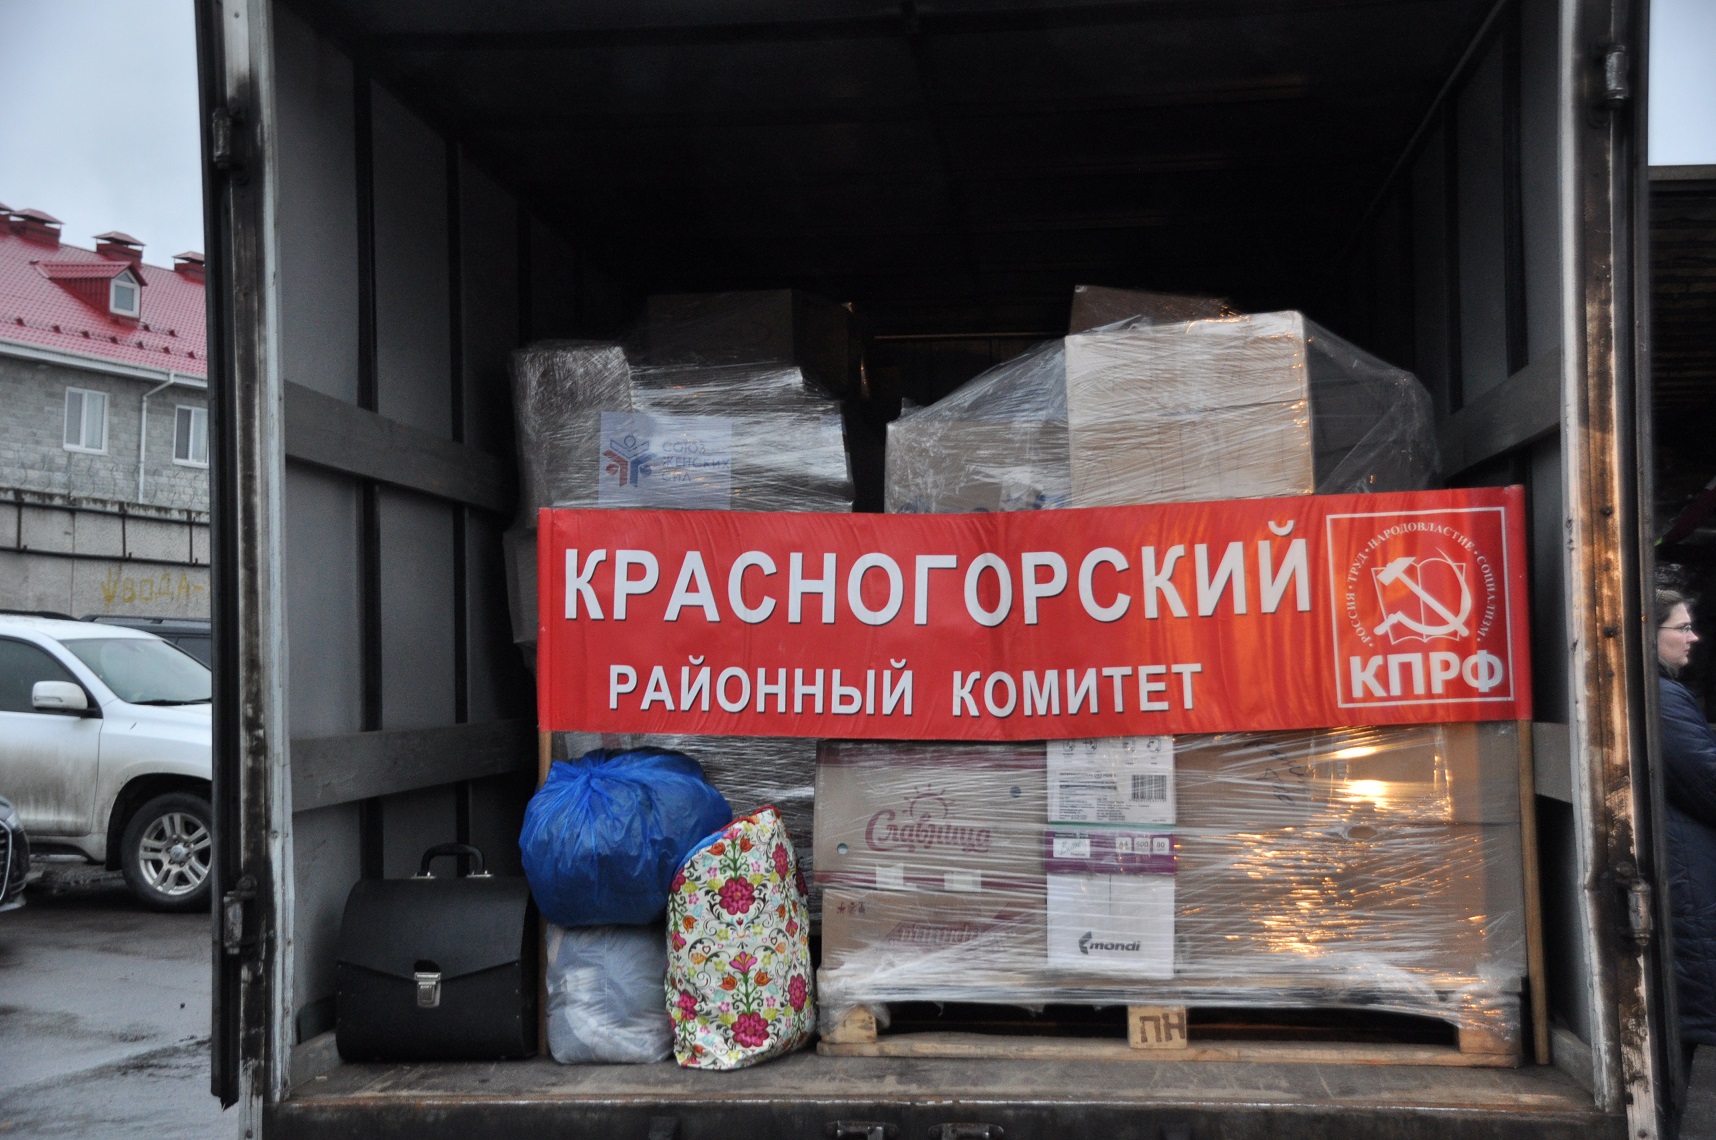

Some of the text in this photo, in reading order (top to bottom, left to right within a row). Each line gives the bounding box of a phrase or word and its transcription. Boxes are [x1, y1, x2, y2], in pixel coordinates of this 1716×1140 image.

[662, 440, 706, 454] СОЮЗ
[662, 456, 730, 469] ЖЕНСКИХ
[564, 519, 1312, 627] КРАСНОГОРСКИЙ
[1345, 521, 1496, 646] РОССИЯ ТРУД НАРОДОВЛАСТИЕ СОЦИАЛИЗМ
[609, 654, 1202, 719] РАЙОННЫЙ КОМИТЕТ
[1349, 649, 1503, 698] КПРФ
[1156, 841, 1165, 849] 80
[1089, 941, 1141, 952] mondi
[1139, 1012, 1186, 1043] ПН
